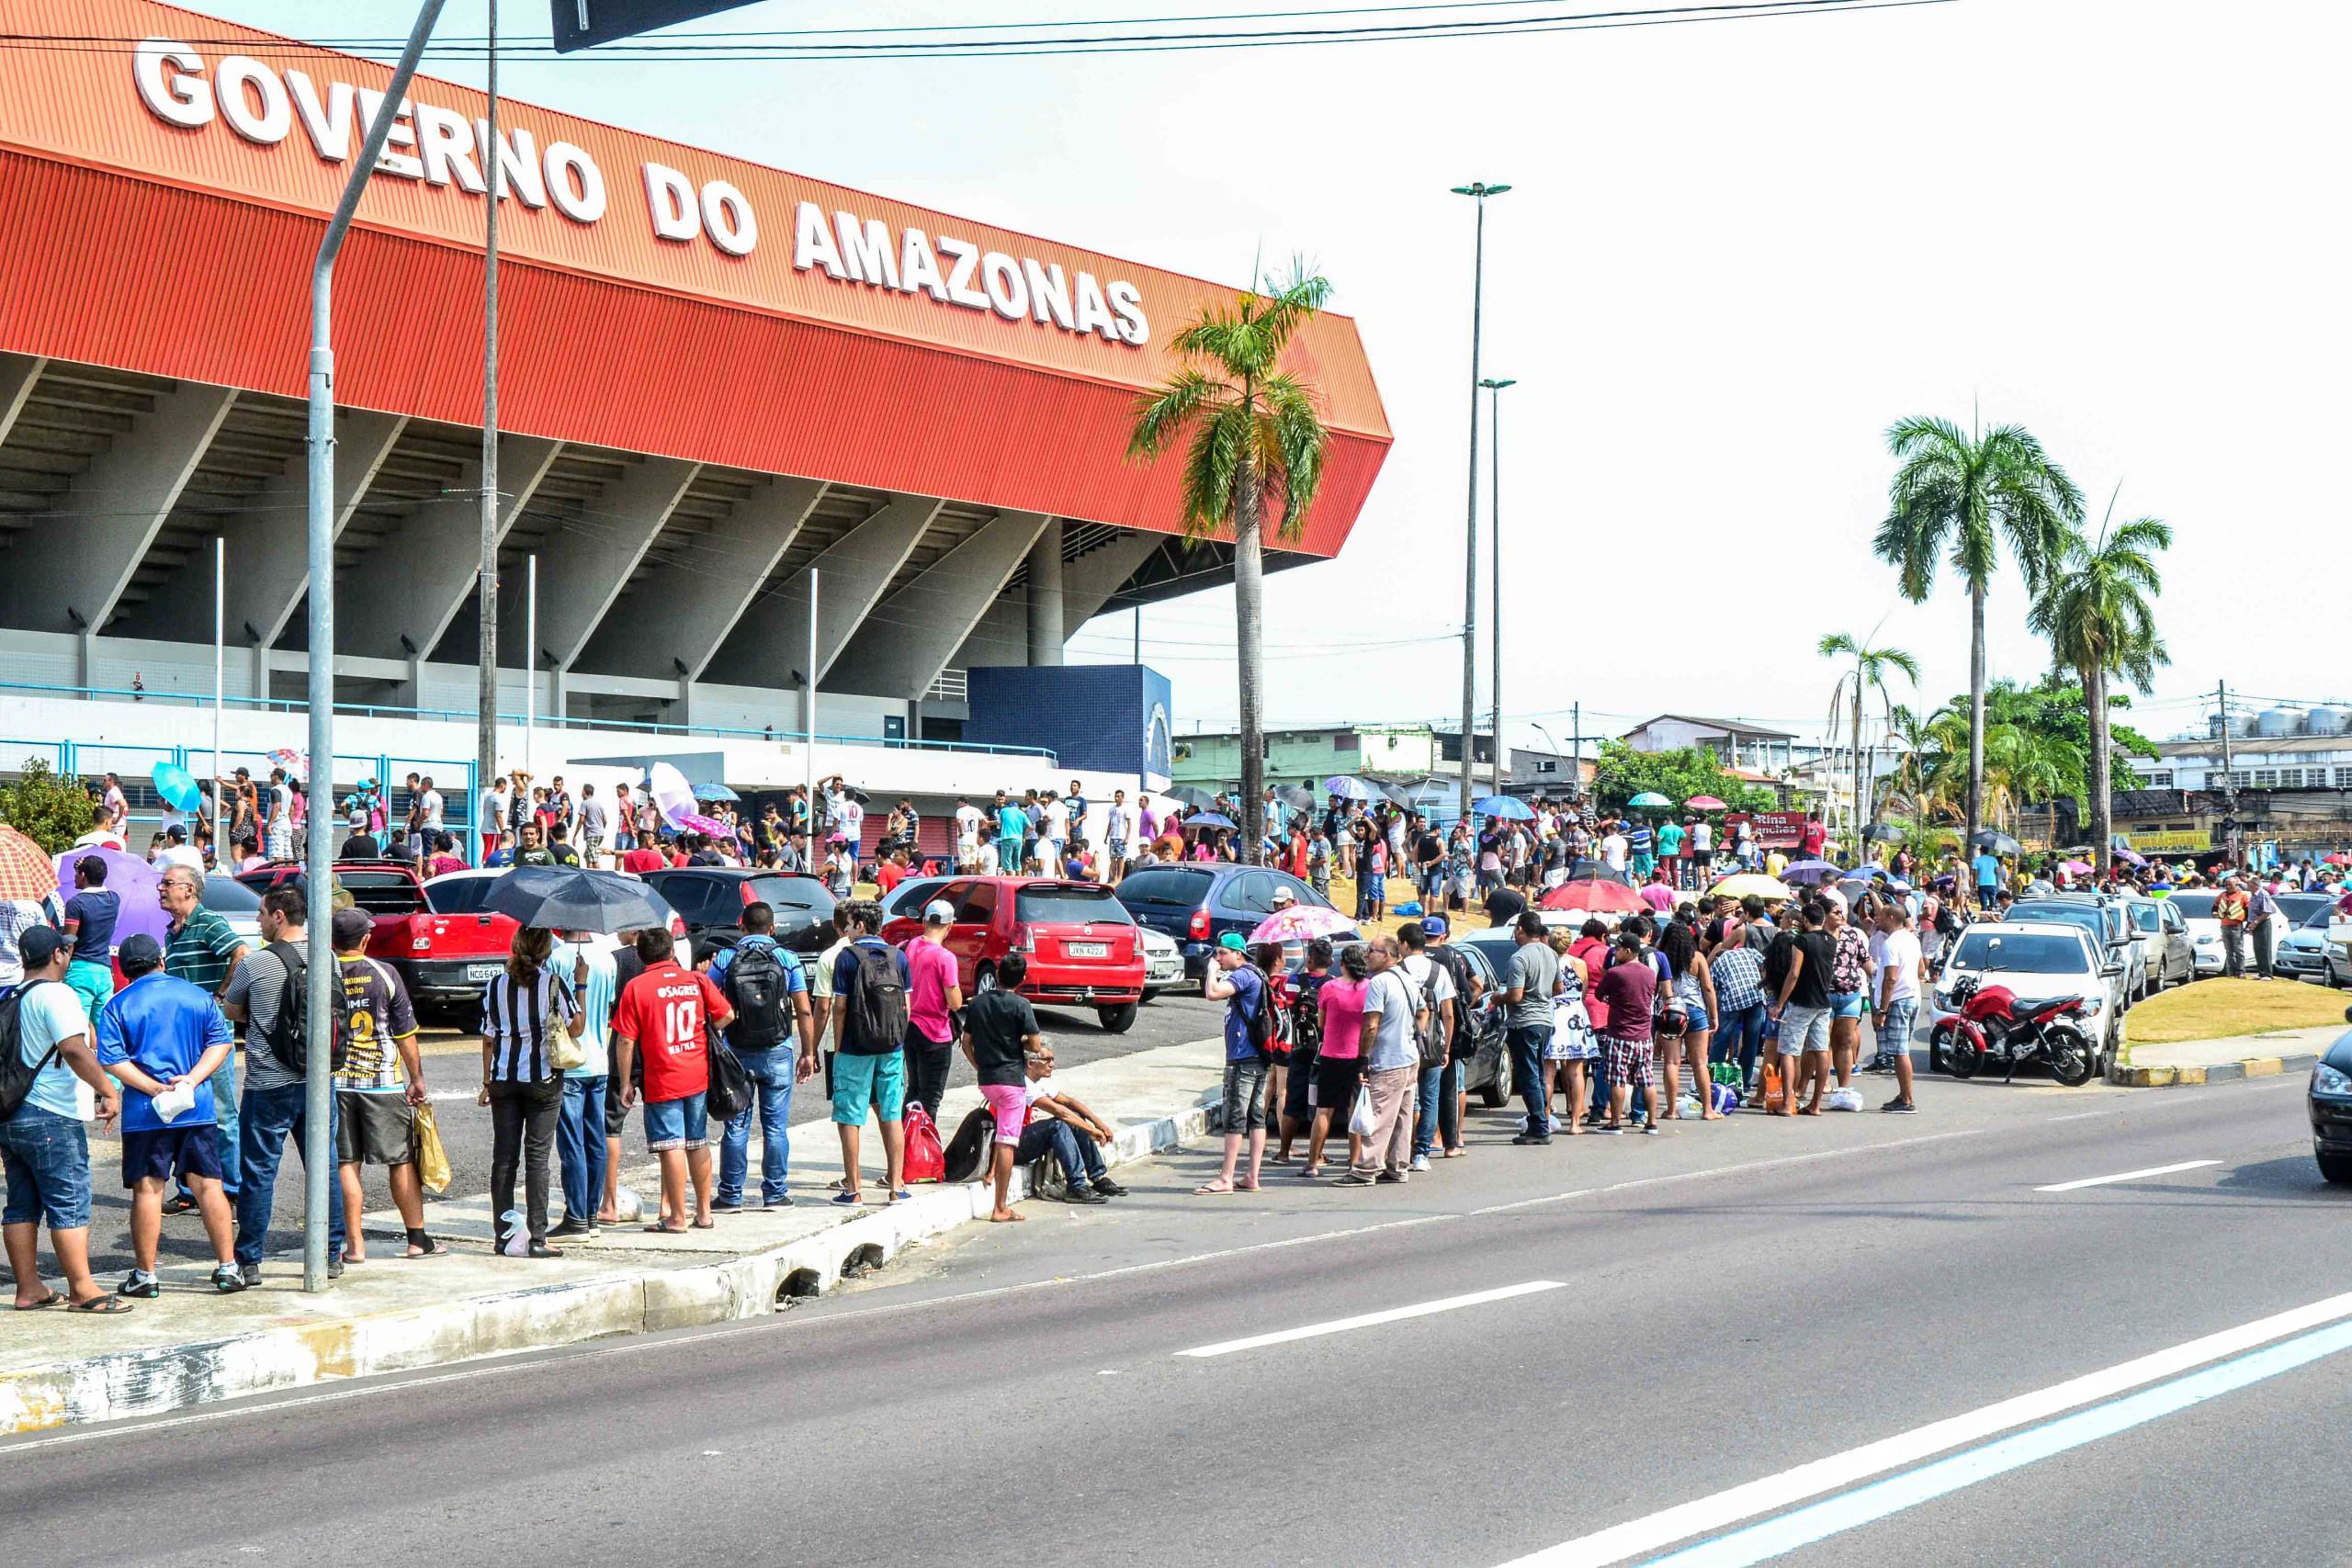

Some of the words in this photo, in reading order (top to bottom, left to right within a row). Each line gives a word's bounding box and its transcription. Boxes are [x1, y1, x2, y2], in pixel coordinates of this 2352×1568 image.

[132, 35, 607, 224] GOVERNO
[643, 163, 758, 257] DO
[793, 200, 1150, 346] AMAZONAS
[665, 985, 699, 998] SAGRES
[666, 1000, 697, 1043] 10
